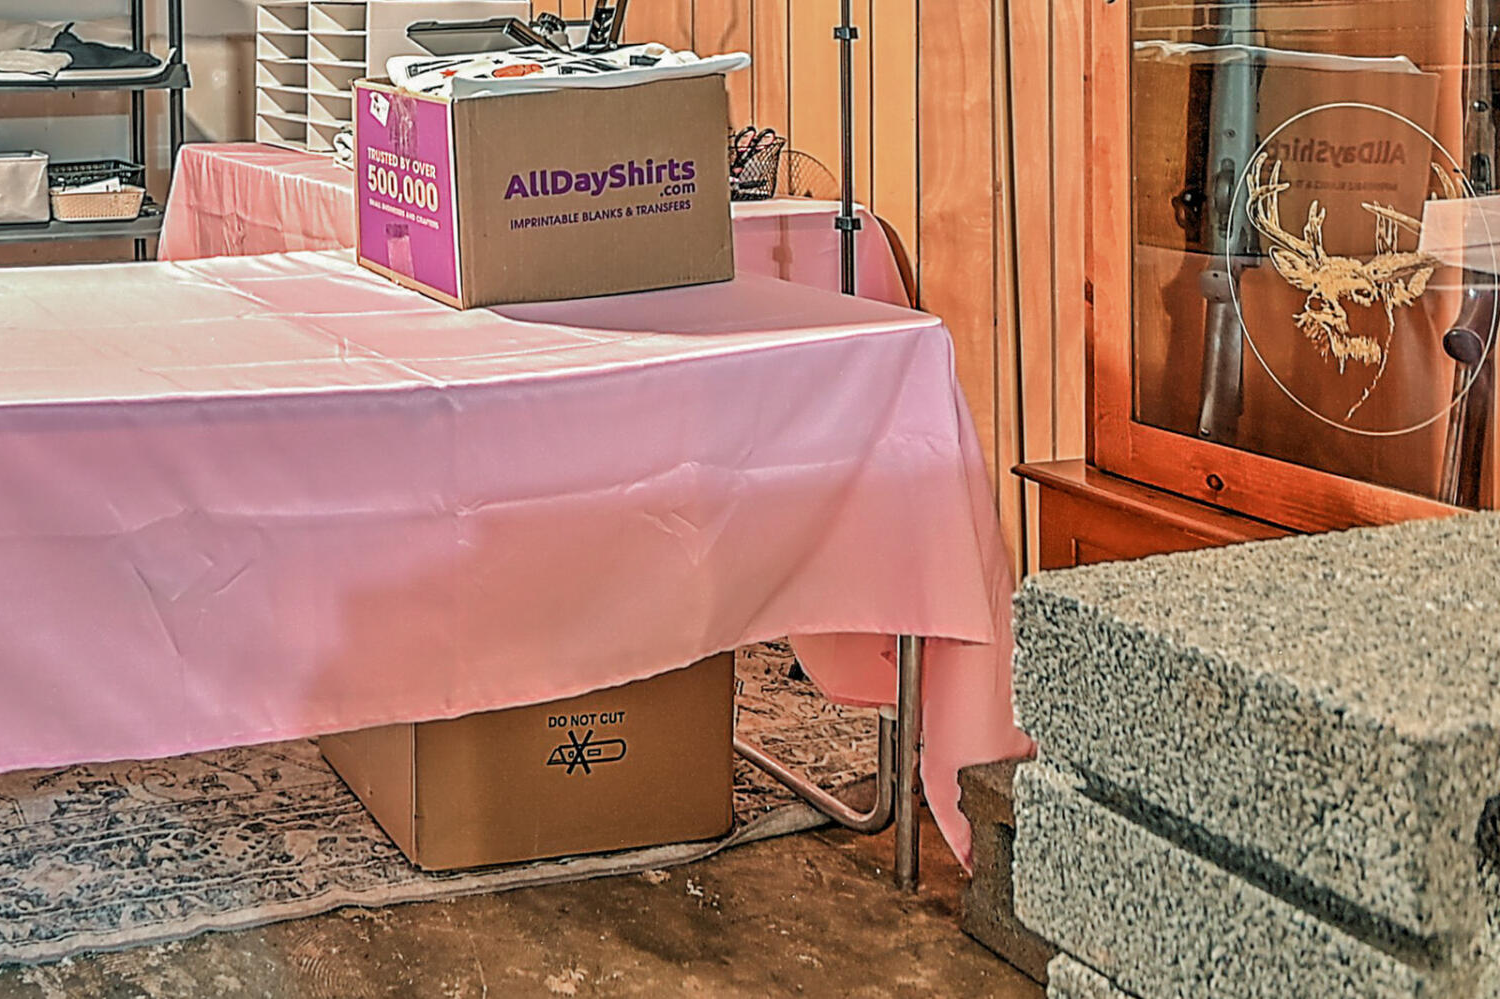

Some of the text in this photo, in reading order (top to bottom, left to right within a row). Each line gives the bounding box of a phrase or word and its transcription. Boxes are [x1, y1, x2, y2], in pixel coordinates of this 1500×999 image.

[367, 146, 436, 179] TRUSTED BY OVER
[367, 164, 438, 212] 500,000
[504, 158, 695, 200] AllDayShirts
[659, 183, 696, 197] .com
[510, 200, 691, 230] IMPRINTABLE BLANKS & TRANSFERS
[548, 712, 625, 728] DO NOT CUT
